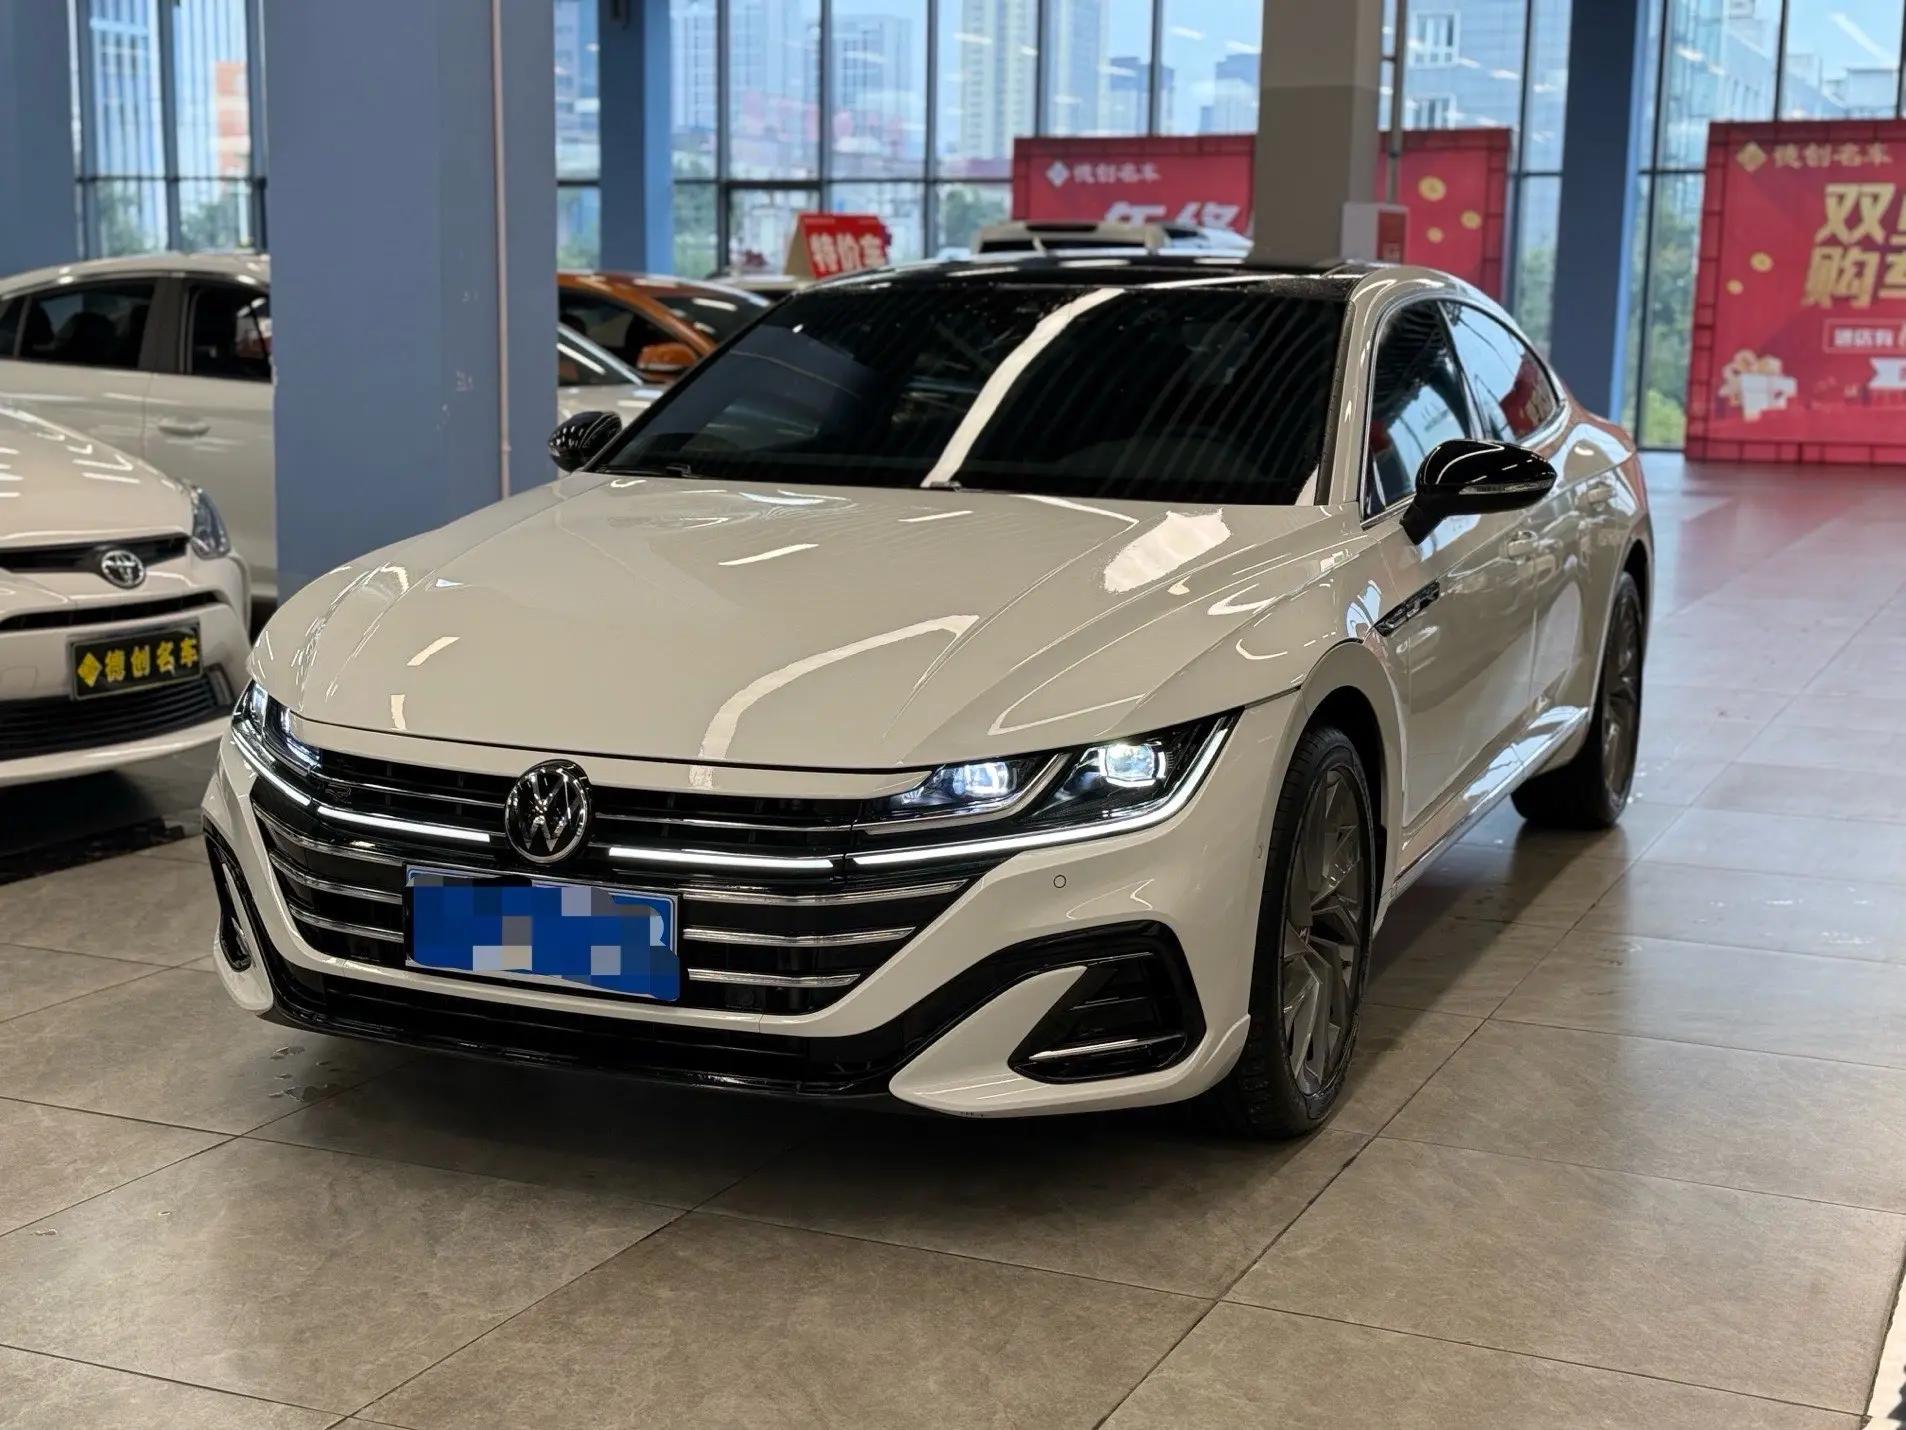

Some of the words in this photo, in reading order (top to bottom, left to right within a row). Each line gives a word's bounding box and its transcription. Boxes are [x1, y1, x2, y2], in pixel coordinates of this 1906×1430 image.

[809, 232, 885, 273] 特价车
[105, 637, 198, 683] 德创名车
